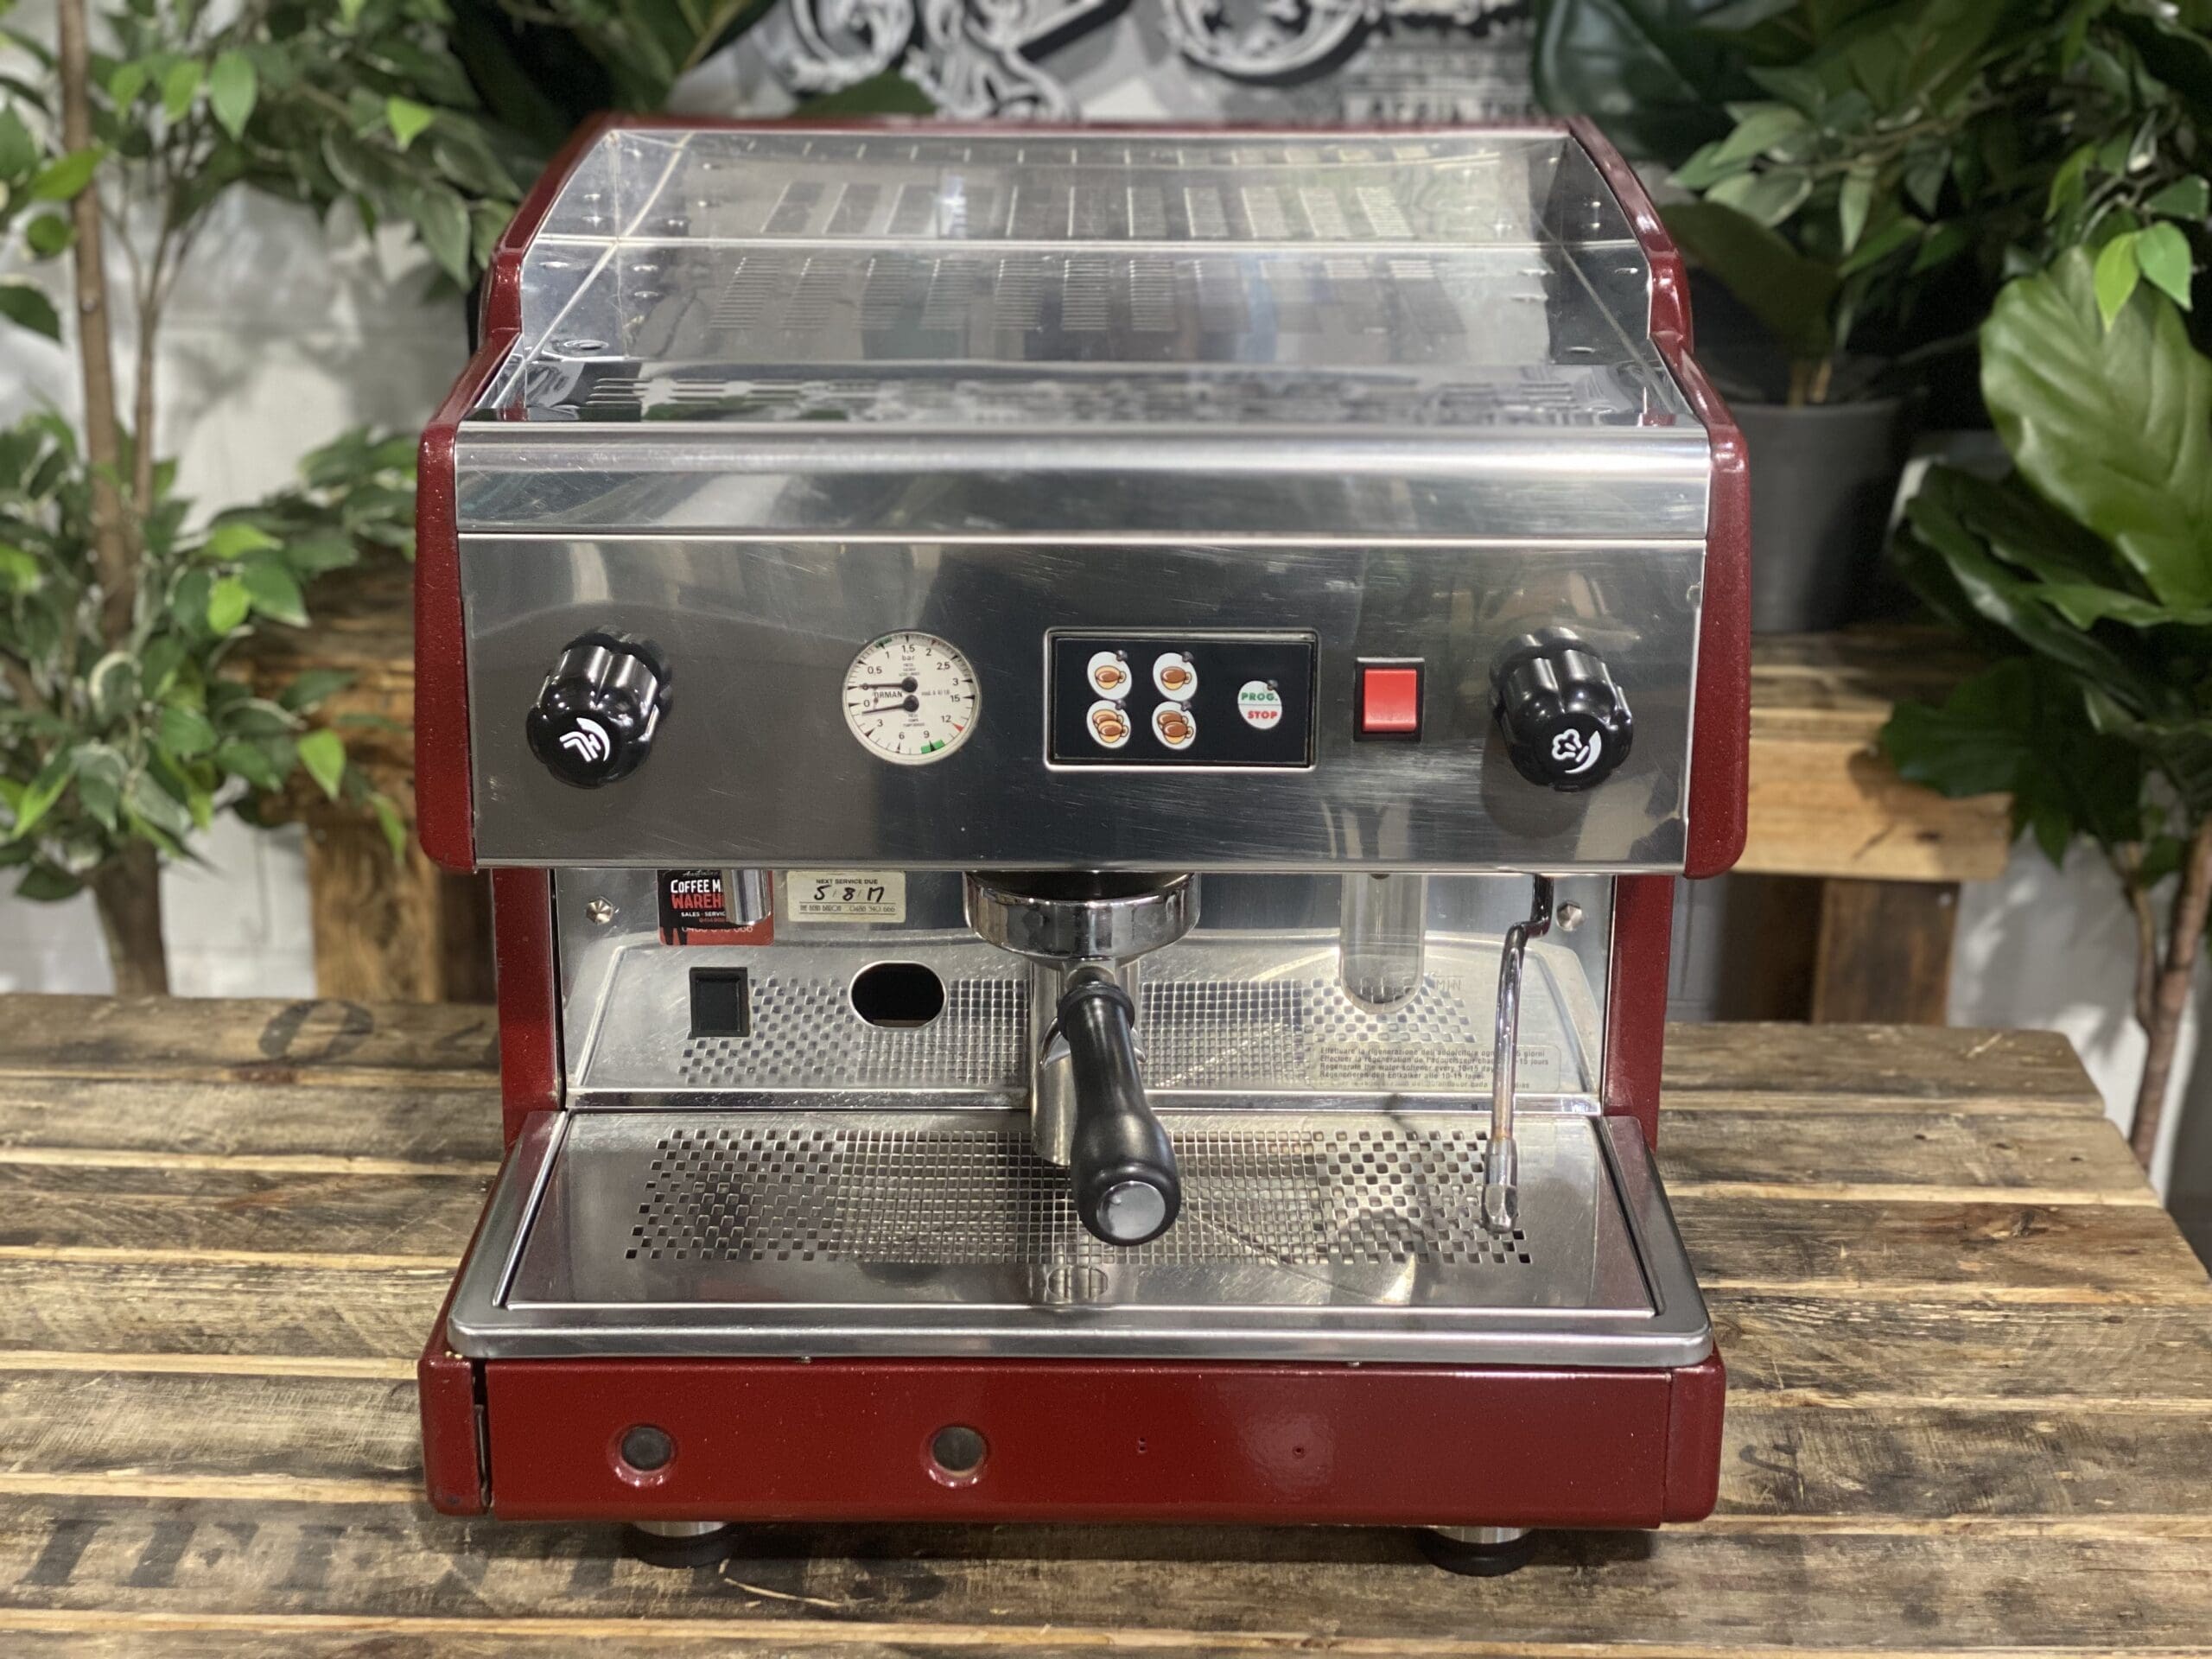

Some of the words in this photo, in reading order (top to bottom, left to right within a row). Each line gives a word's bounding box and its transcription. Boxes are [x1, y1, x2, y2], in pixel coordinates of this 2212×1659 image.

[925, 648, 931, 657] 2
[1241, 692, 1278, 702] PROG.
[863, 699, 870, 708] 0
[941, 715, 951, 723] 12
[1247, 710, 1278, 720] STOP
[877, 719, 883, 728] 3
[899, 732, 905, 741] 6
[924, 730, 930, 739] 9
[671, 879, 710, 893] COFFEE
[842, 887, 856, 901] 8
